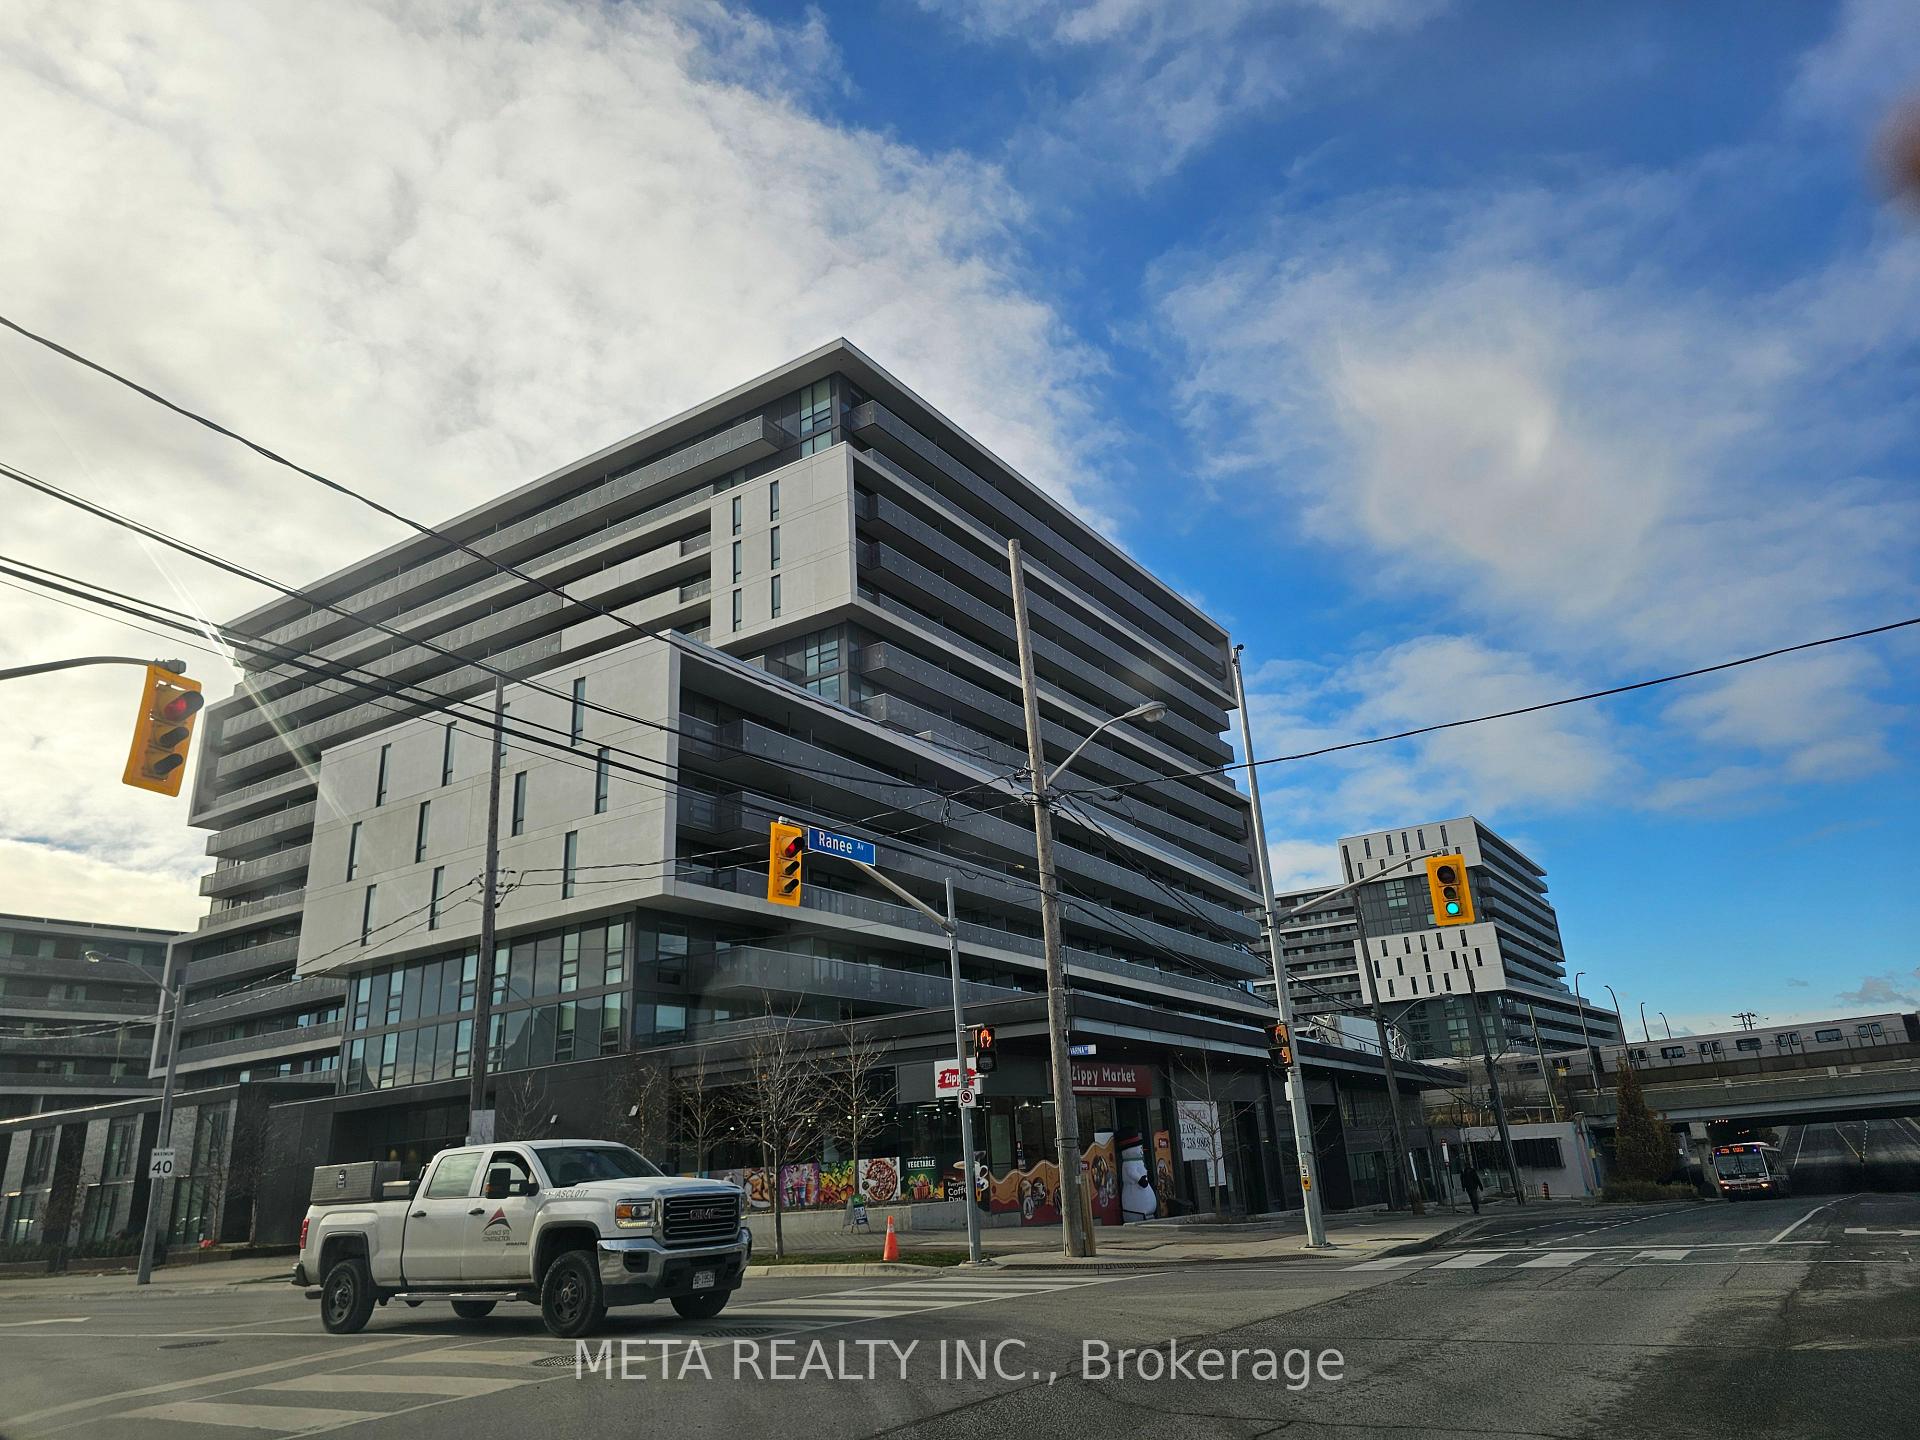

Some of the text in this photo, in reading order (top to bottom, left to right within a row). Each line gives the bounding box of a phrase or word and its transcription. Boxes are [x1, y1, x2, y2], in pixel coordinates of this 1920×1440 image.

[818, 831, 853, 854] Ranee
[1071, 1065, 1136, 1085] Zippy Market
[151, 1160, 173, 1174] 40
[907, 1160, 936, 1169] VEGETABLE
[689, 1208, 720, 1220] GMC
